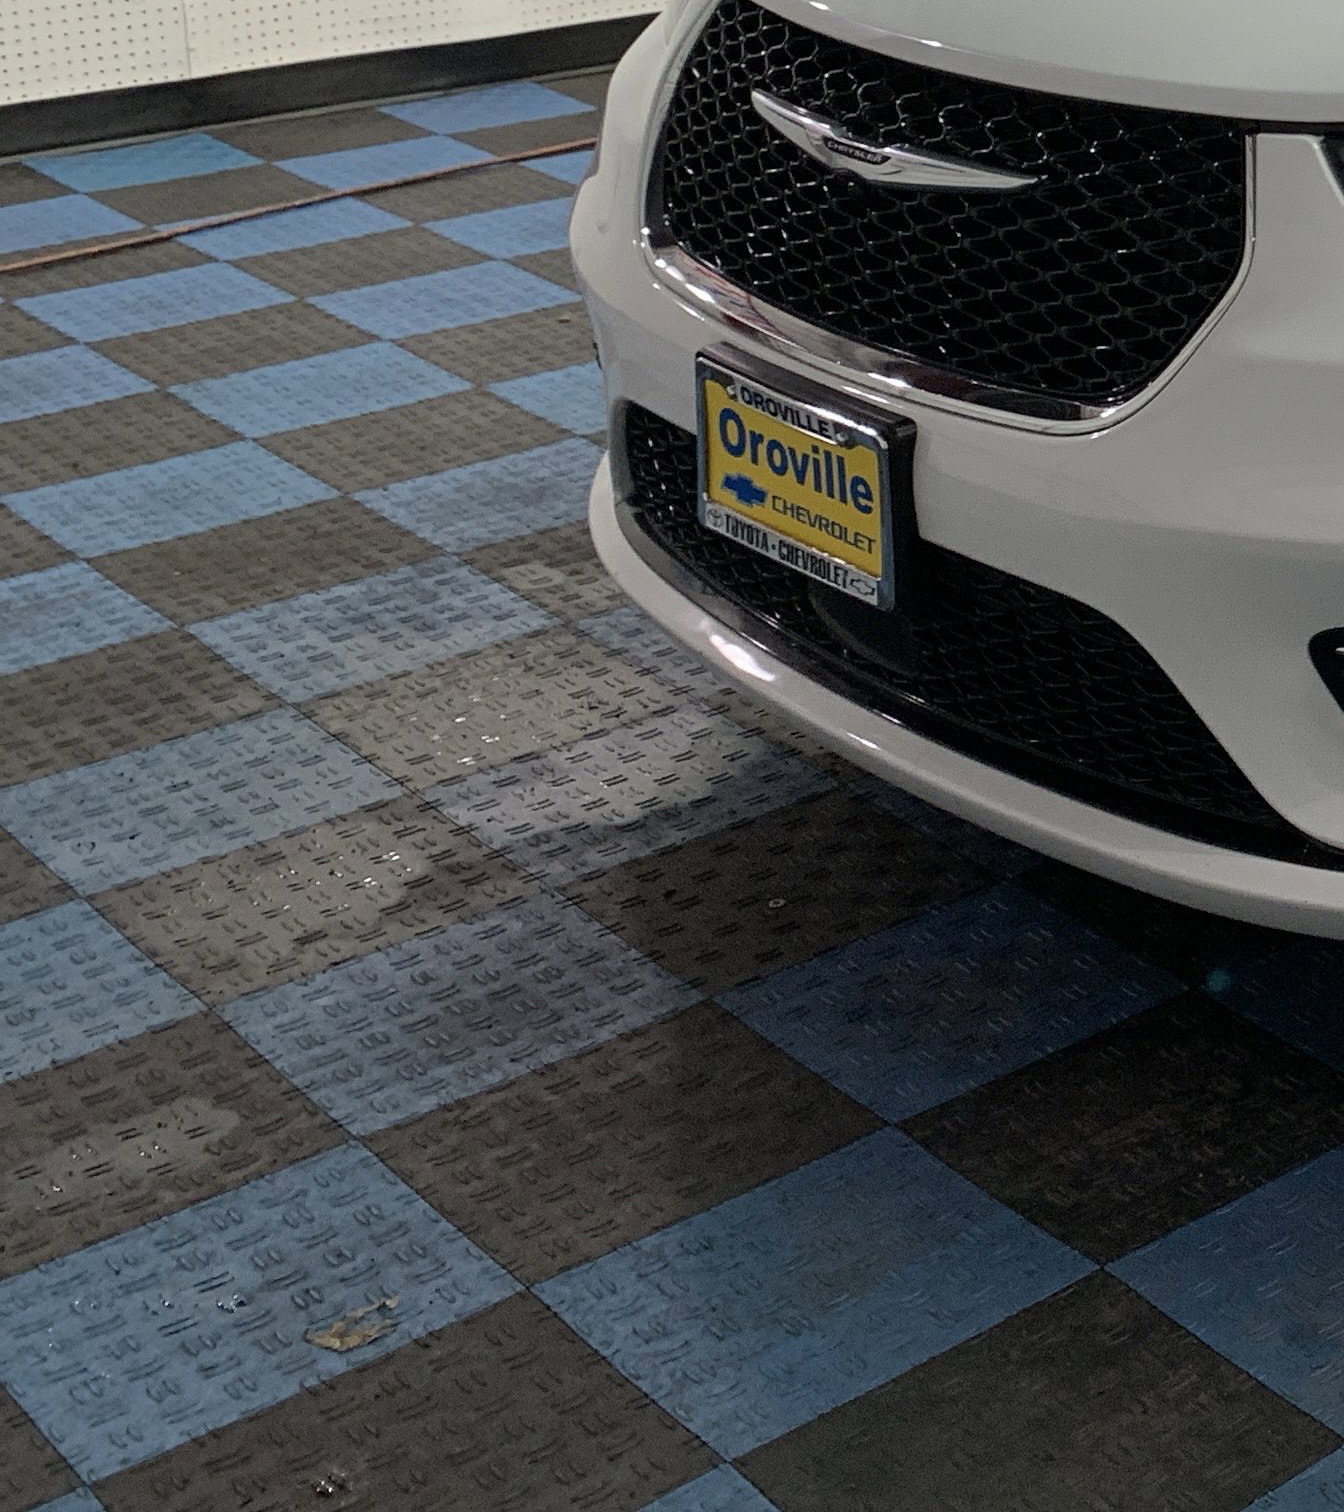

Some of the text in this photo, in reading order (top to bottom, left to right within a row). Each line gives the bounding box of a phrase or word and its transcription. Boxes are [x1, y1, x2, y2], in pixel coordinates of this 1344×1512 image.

[740, 385, 829, 435] OROVILLE
[719, 407, 874, 515] Oroville
[724, 513, 849, 590] TOYOTA CHEVROLET
[772, 494, 876, 554] CHEVROLET
